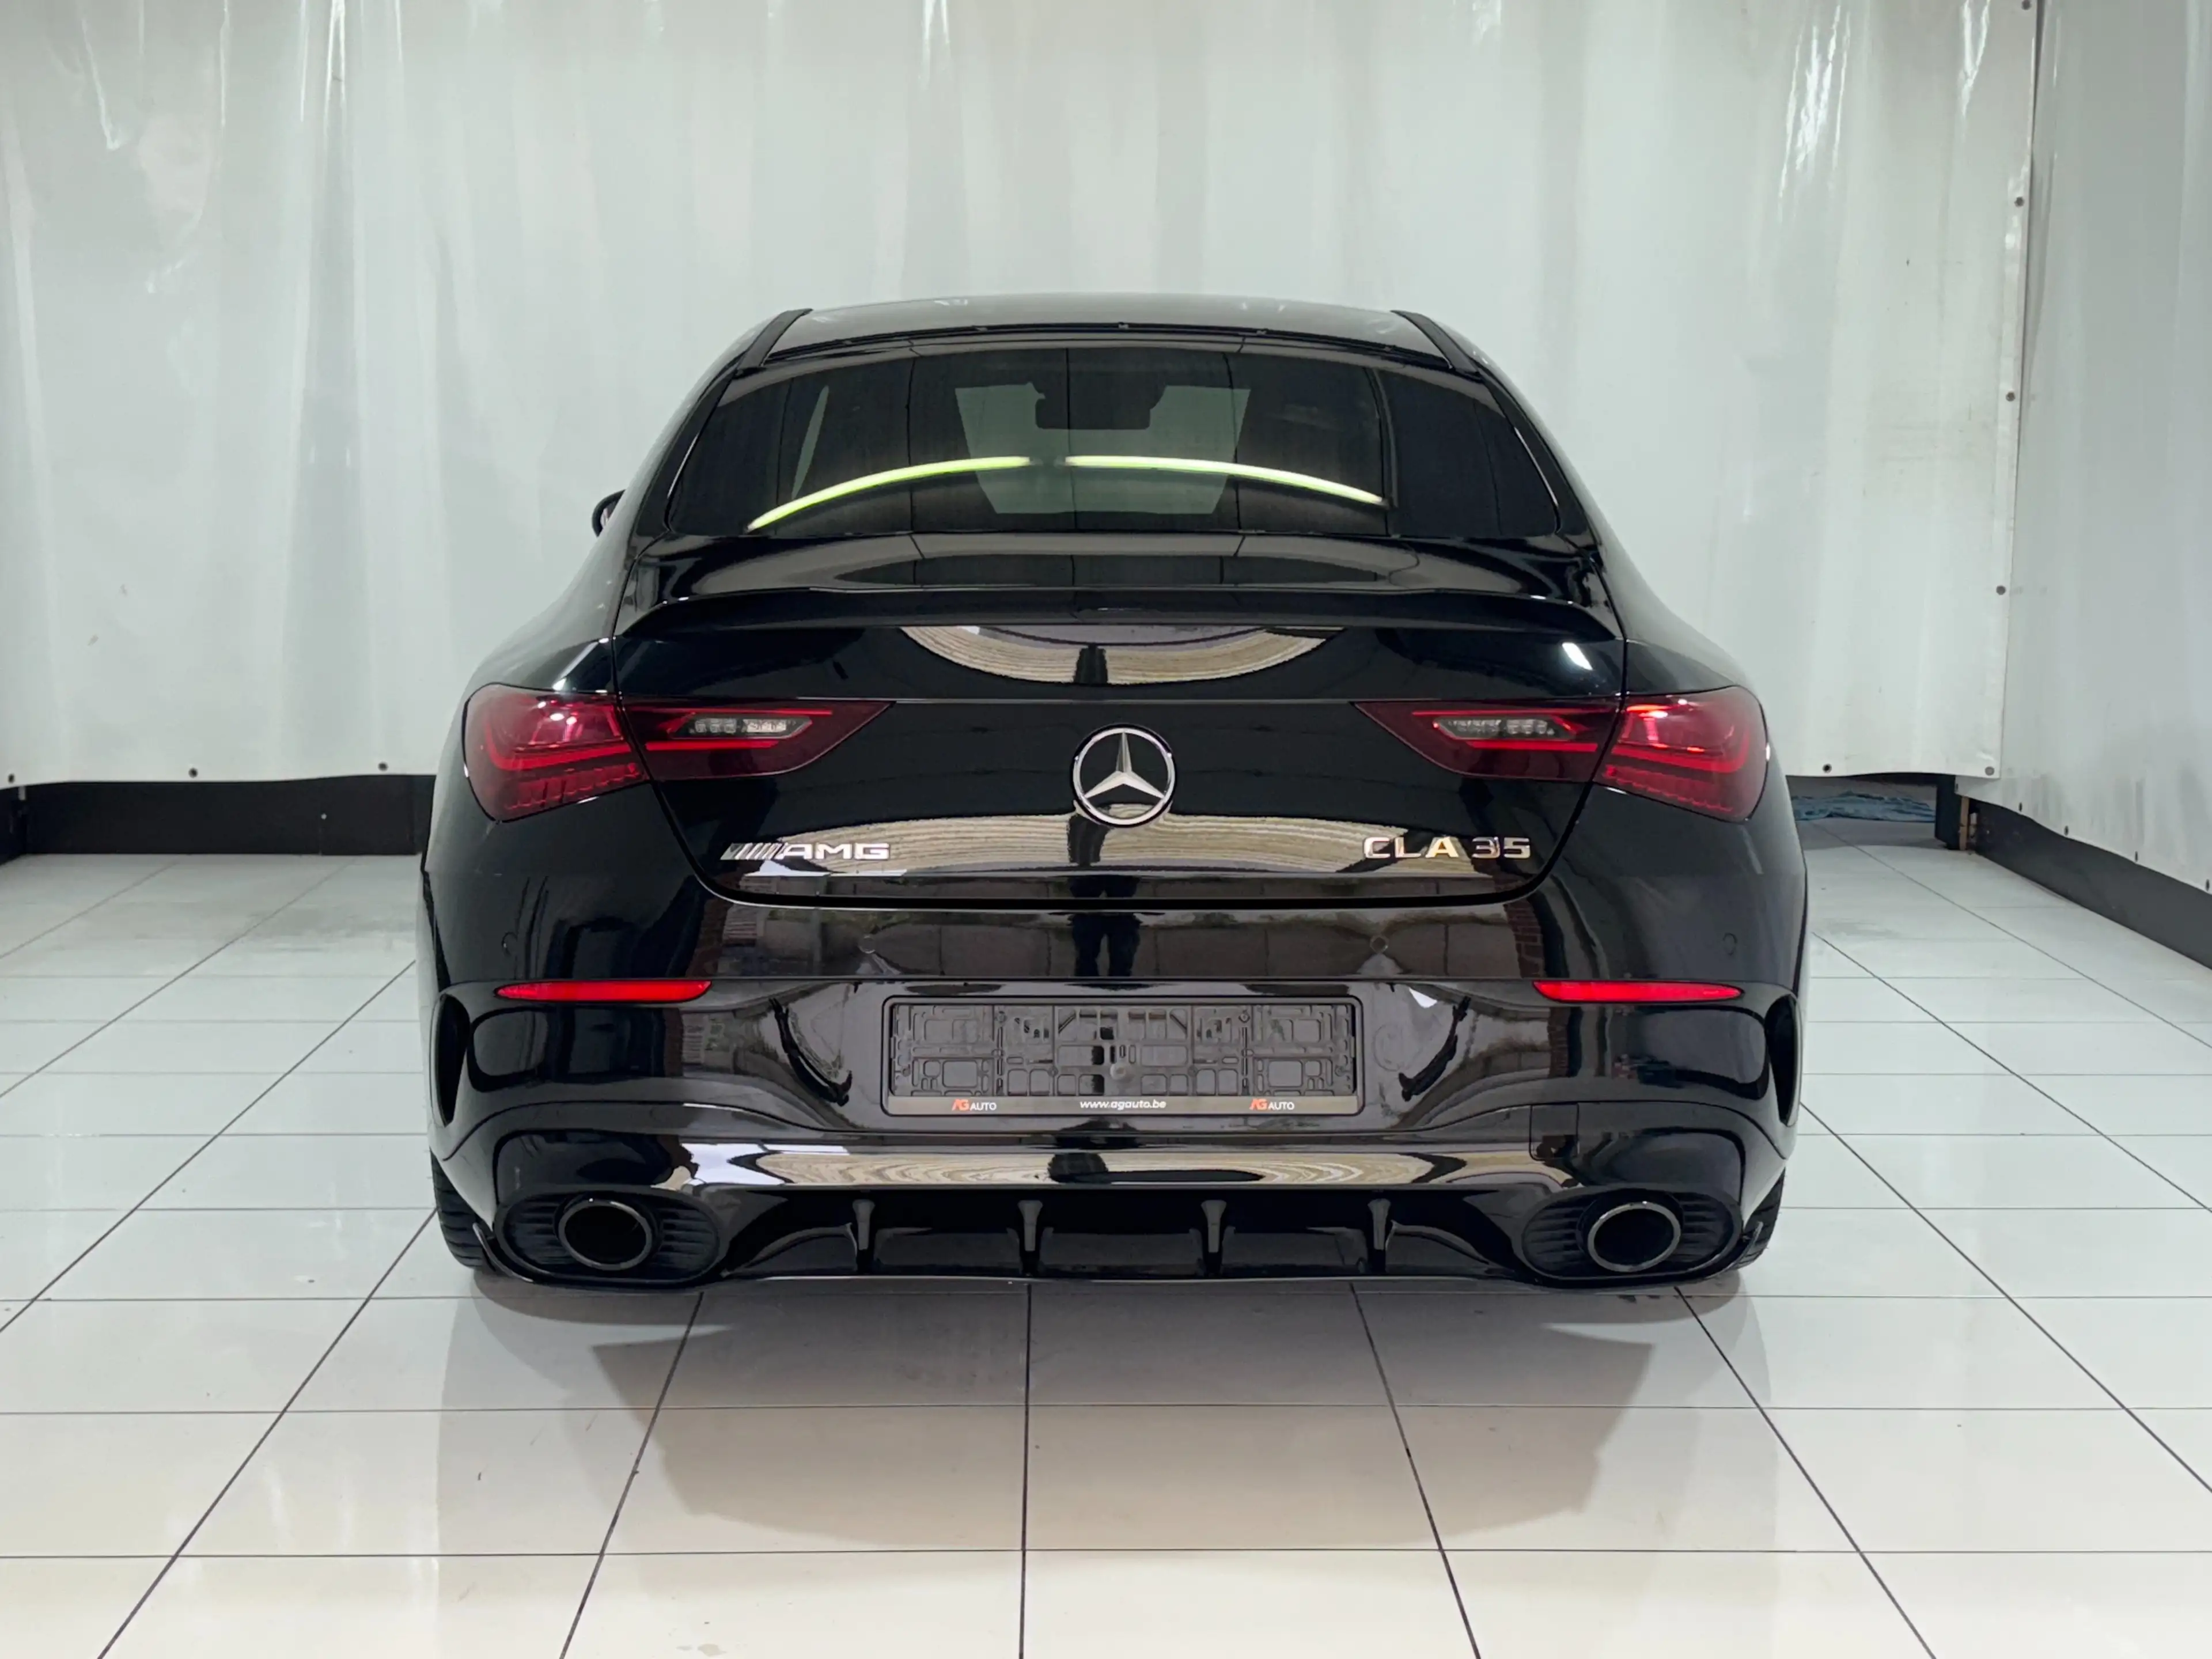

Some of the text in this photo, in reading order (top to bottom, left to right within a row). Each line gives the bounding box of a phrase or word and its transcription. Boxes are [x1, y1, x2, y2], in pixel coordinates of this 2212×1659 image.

[774, 843, 889, 860] AMG
[1363, 836, 1531, 859] CLA 35
[969, 1101, 997, 1111] AUTO
[1080, 1099, 1167, 1111] www.agauto.be
[1267, 1101, 1296, 1111] AUTO
